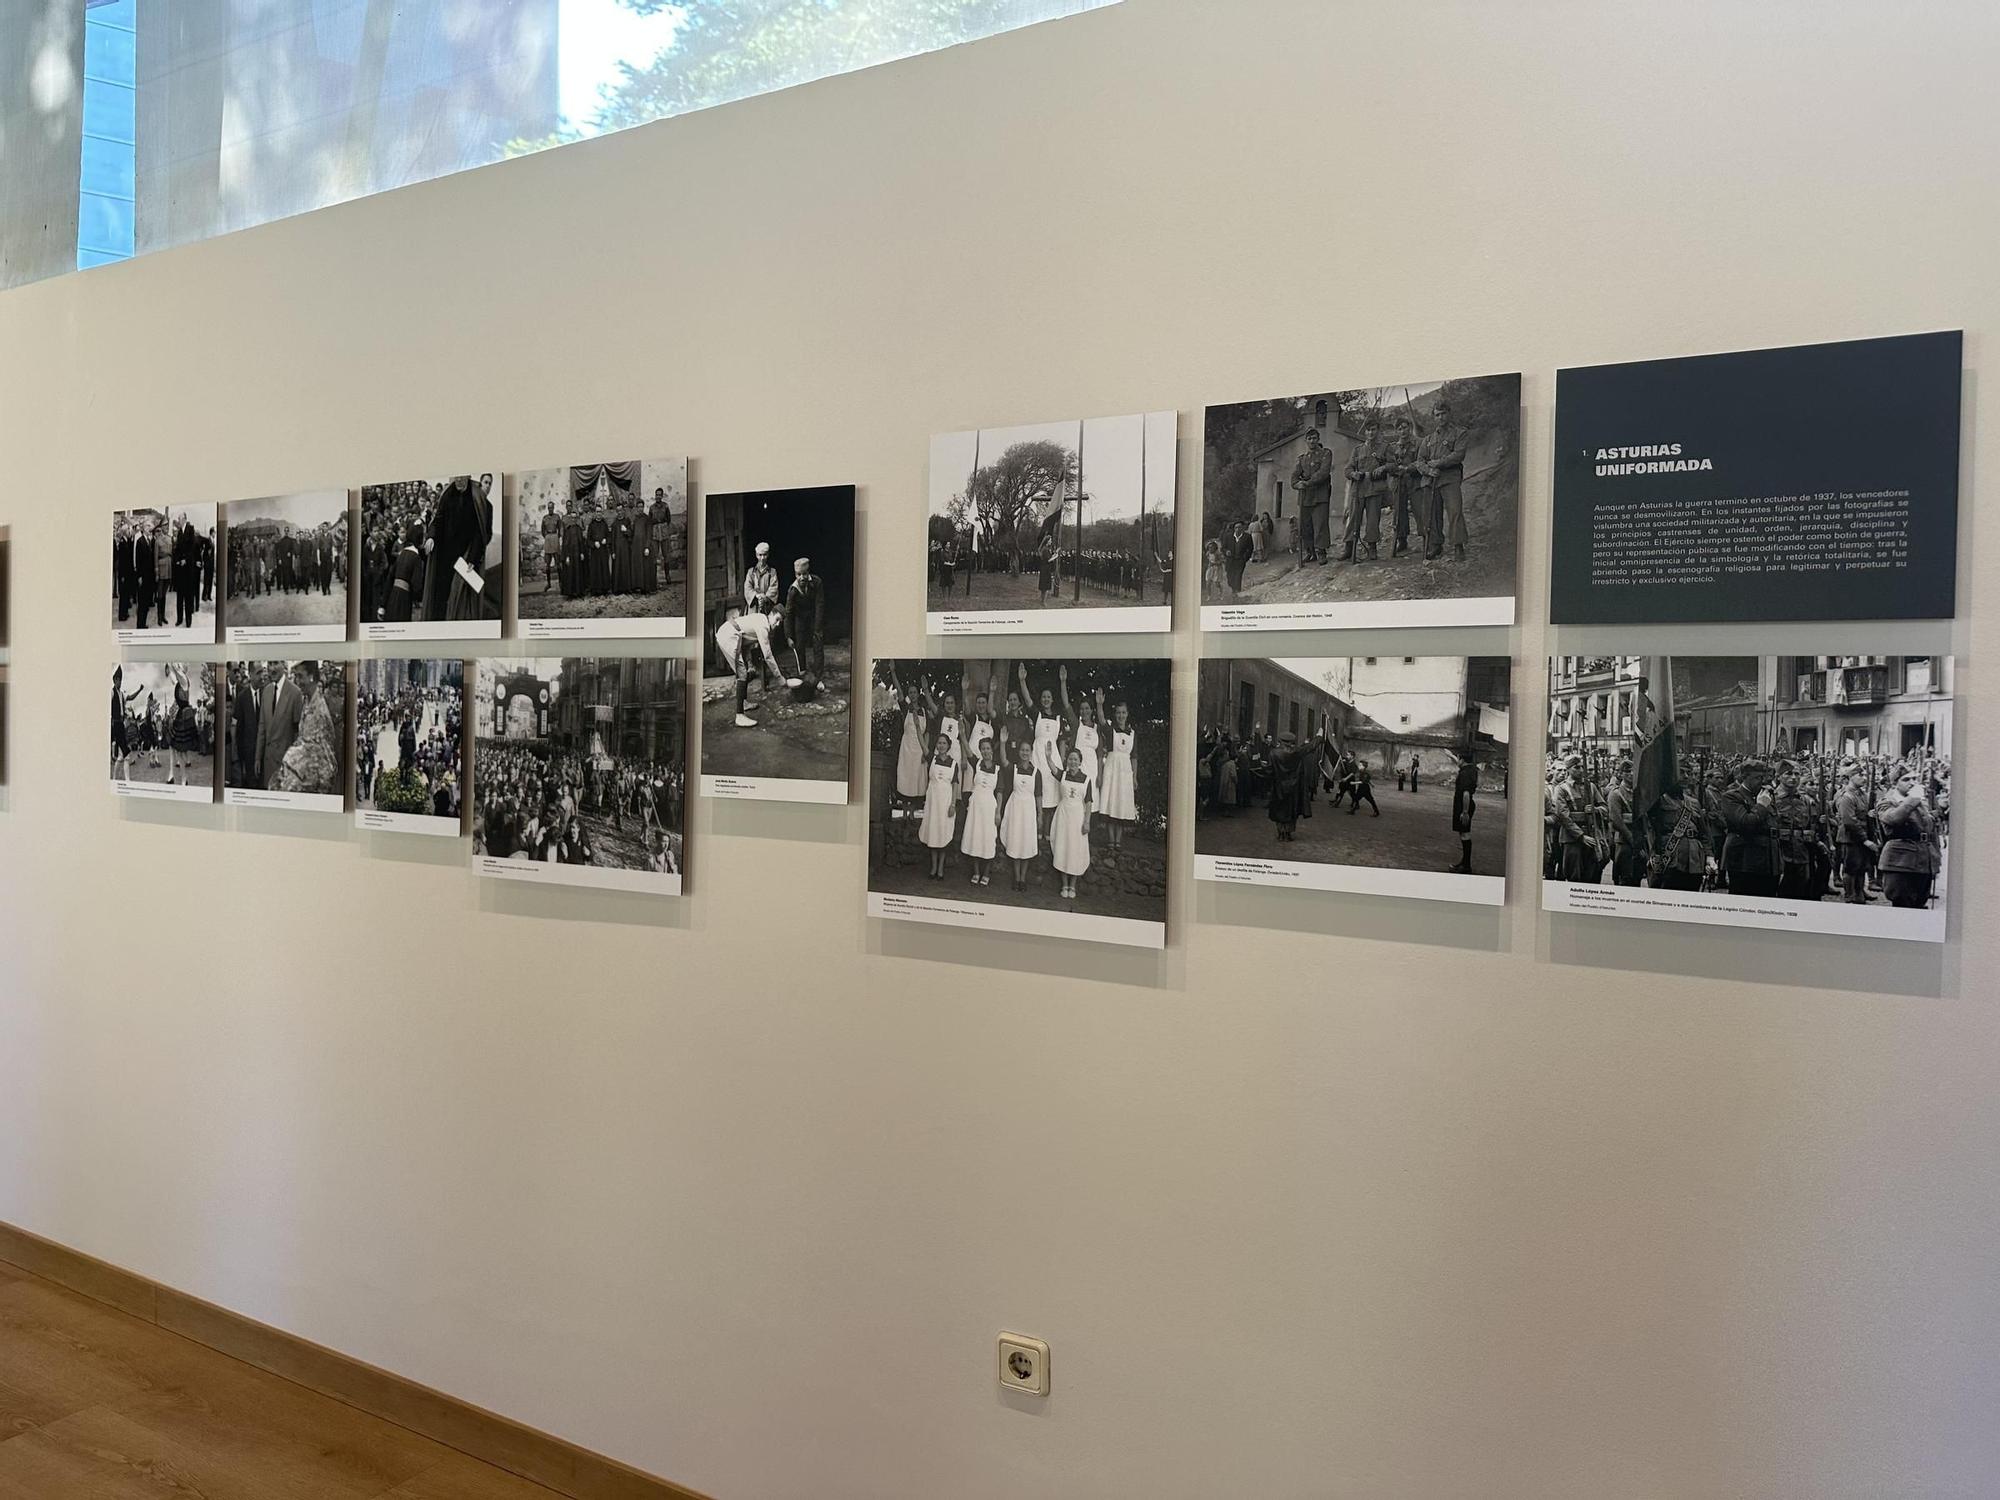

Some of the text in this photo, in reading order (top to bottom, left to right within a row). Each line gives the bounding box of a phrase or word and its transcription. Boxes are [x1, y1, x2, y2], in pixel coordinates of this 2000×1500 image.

[1595, 443, 1682, 460] ASTURIAS
[1595, 458, 1713, 477] UNIFORMADA
[1593, 501, 1625, 512] Aunque
[1627, 502, 1637, 510] en
[1639, 499, 1673, 509] Asturias
[1684, 499, 1712, 507] guerra
[1714, 496, 1748, 505] terminó
[1763, 494, 1797, 503] octubre
[1799, 493, 1811, 501] de
[1839, 491, 1853, 499] los
[1855, 489, 1909, 499] vencedores
[1633, 508, 1697, 519] desmovilizaron.
[1701, 507, 1713, 515] En
[1716, 506, 1728, 514] los
[1732, 505, 1771, 514] instantes
[1807, 504, 1824, 512] por
[1827, 502, 1840, 510] las
[1844, 499, 1894, 511] fotografías
[1593, 520, 1633, 530] vislumbra
[1652, 518, 1688, 526] sociedad
[1690, 516, 1739, 525] militarizada
[1749, 513, 1796, 523] autoritaria,
[1812, 512, 1822, 520] la
[1822, 513, 1840, 521] que
[1855, 509, 1908, 520] impusieron
[1592, 530, 1605, 539] los
[1611, 529, 1651, 540] principios
[1657, 527, 1701, 536] castrenses
[1707, 526, 1718, 534] de
[1724, 525, 1758, 534] unidad,
[1764, 523, 1792, 532] orden,
[1849, 519, 1895, 530] disciplina
[1592, 538, 1651, 548] subordinación.
[1664, 537, 1695, 546] Ejército
[1696, 535, 1730, 545] siempre
[1732, 534, 1765, 543] ostentó
[1767, 534, 1776, 542] el
[1777, 533, 1804, 543] poder
[1860, 531, 1871, 539] de
[1874, 531, 1907, 540] guerra,
[1592, 550, 1611, 559] pero
[1625, 547, 1686, 558] representación
[1688, 546, 1718, 555] pública
[1750, 543, 1806, 552] modificando
[1828, 542, 1836, 550] el
[1877, 540, 1895, 548] tras
[1898, 540, 1907, 548] la
[1592, 558, 1616, 567] inicial
[1619, 556, 1680, 567] omnipresencia
[1684, 555, 1695, 563] de
[1699, 555, 1707, 563] la
[1711, 554, 1759, 564] simbología
[1773, 553, 1781, 561] la
[1824, 550, 1871, 560] totalitaria,
[1892, 549, 1907, 557] fue
[1591, 567, 1627, 576] abriendo
[1631, 567, 1652, 576] paso
[1667, 564, 1720, 574] escenografía
[1724, 563, 1761, 573] religiosa
[1765, 564, 1785, 572] para
[1591, 576, 1630, 585] irrestricto
[1638, 575, 1677, 584] exclusivo
[1678, 574, 1715, 583] ejercicio.
